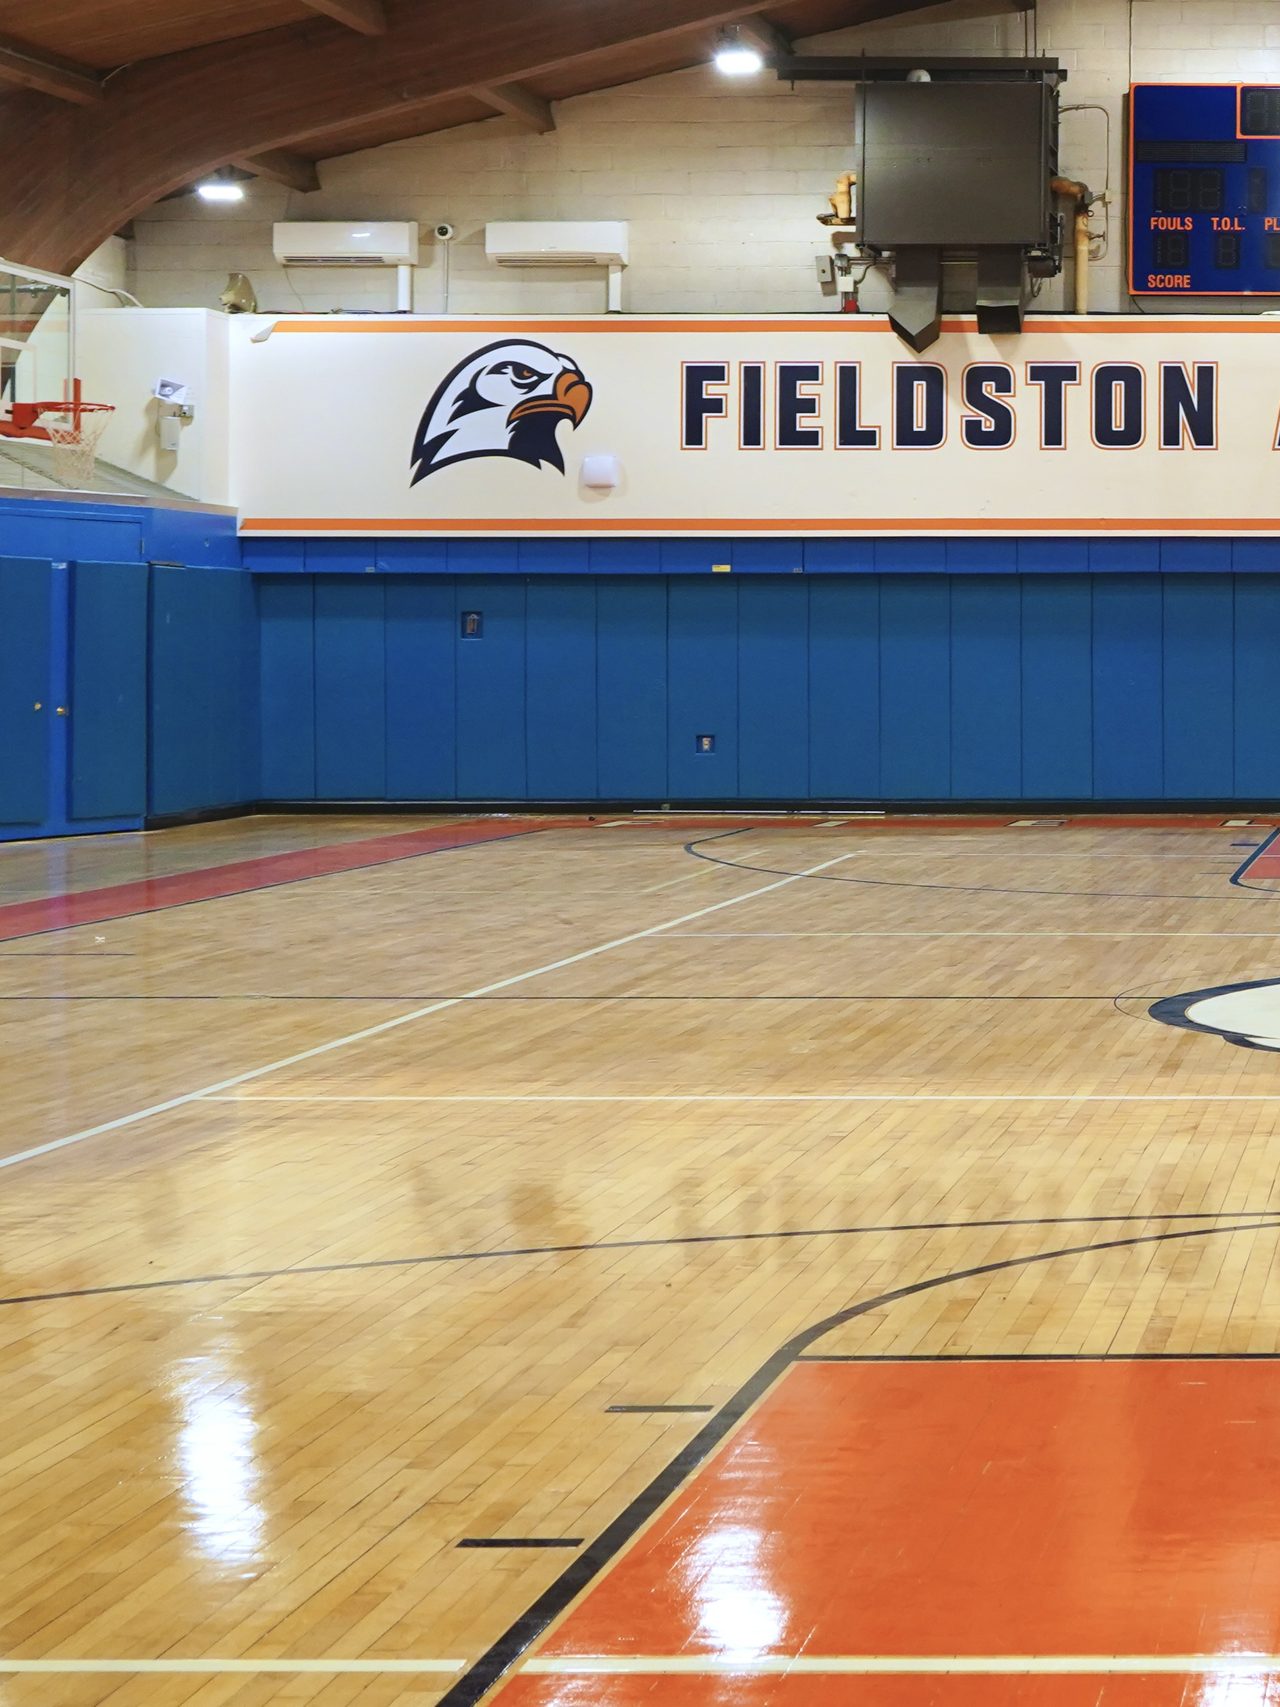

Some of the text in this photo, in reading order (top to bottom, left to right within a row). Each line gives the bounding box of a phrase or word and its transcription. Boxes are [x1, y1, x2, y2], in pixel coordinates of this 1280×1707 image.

[1150, 217, 1193, 231] FOULS
[1211, 217, 1245, 231] T.O.L.
[1148, 274, 1191, 288] SCORE
[680, 360, 1219, 451] FIELDSTON
